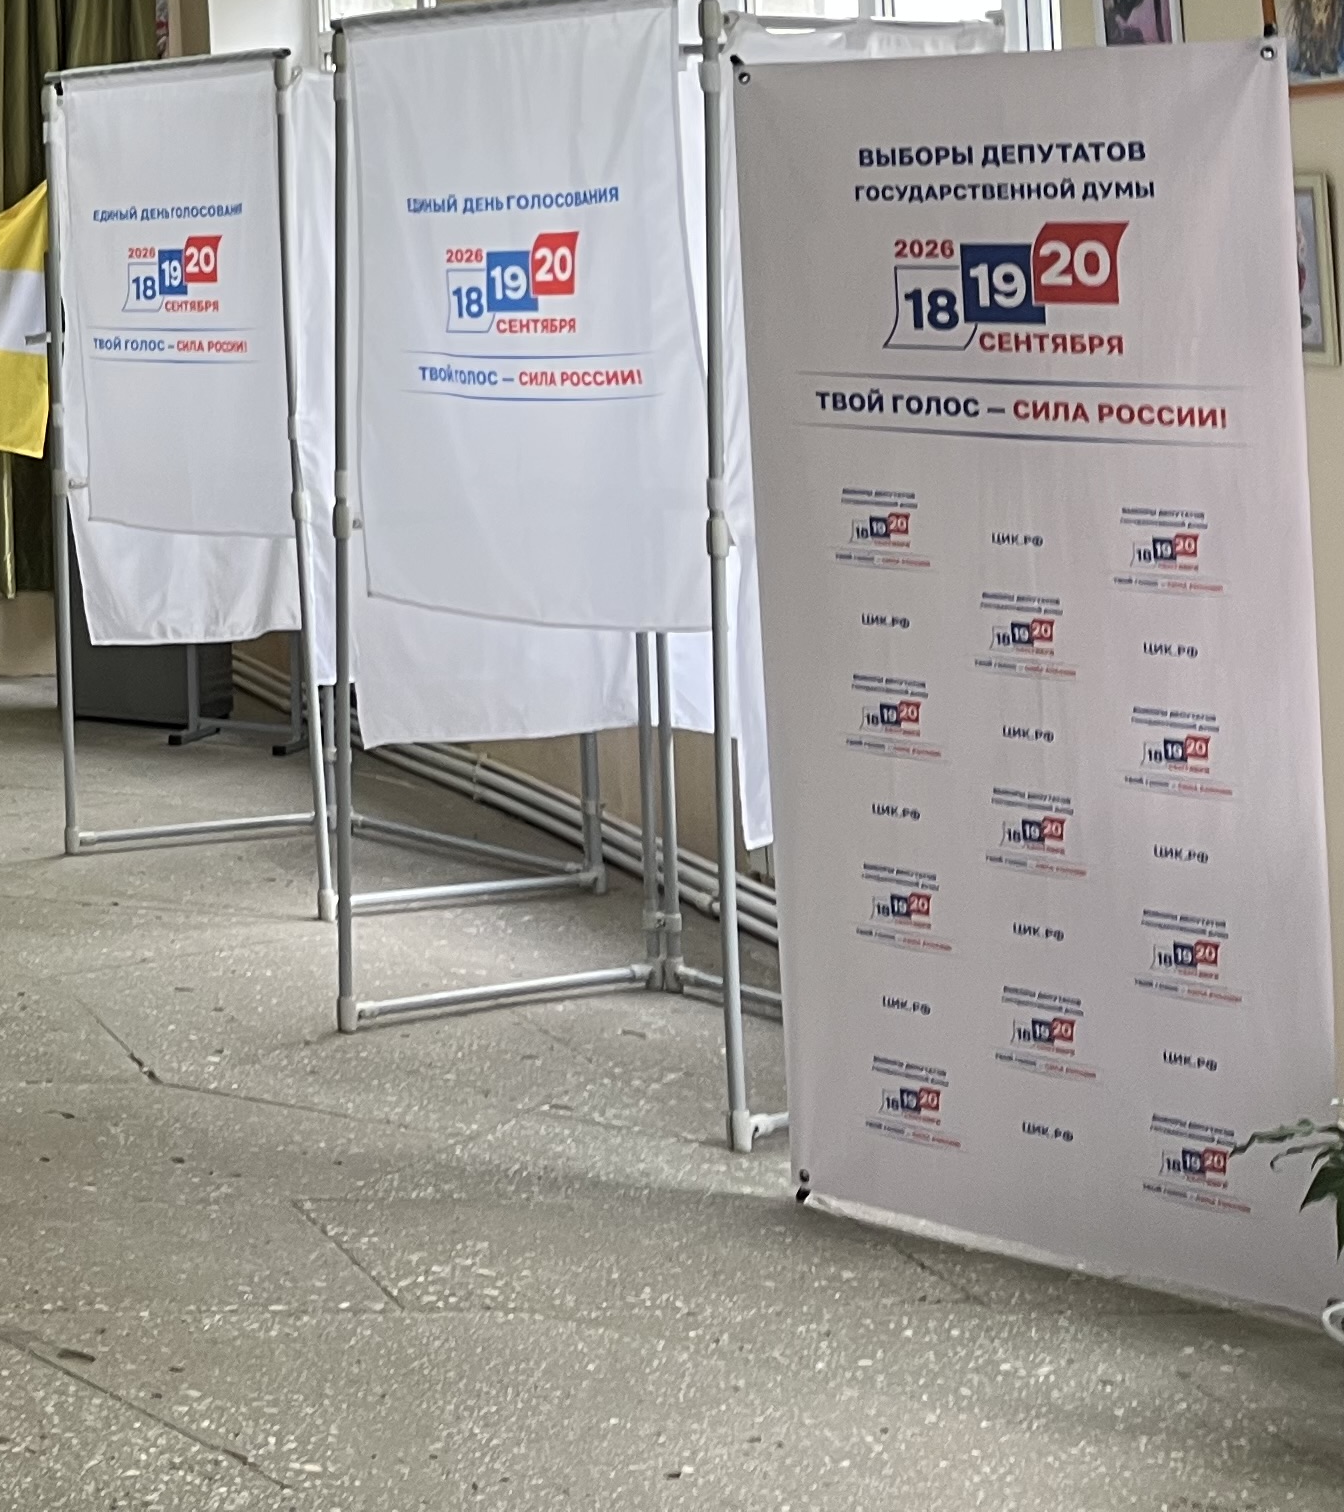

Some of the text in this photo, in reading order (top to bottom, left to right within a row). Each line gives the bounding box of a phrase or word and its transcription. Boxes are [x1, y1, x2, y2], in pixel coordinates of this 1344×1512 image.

[858, 141, 1146, 169] ВЫБОРЫ ДЕПУТАТОВ
[855, 178, 1155, 203] ГОСУДАРСТВЕННОЙ ДУМЫ
[463, 195, 503, 214] ДЕНЬ
[506, 186, 620, 211] ГОЛОСОВАНИЯ
[93, 206, 138, 223] ЕДИНЫЙ
[140, 207, 170, 222] ДЕНЬ
[128, 247, 155, 259] 2026
[446, 249, 483, 263] 2026
[895, 240, 955, 259] 2026
[132, 246, 215, 301] 18 19 20
[452, 246, 573, 319] 18 19 20
[904, 240, 1111, 331] 18 19 20
[165, 300, 220, 313] СЕНТЯБРЯ
[496, 318, 577, 334] СЕНТЯБРЯ
[93, 336, 122, 351] ТВОЙ
[124, 338, 165, 352] ГОЛОС
[176, 340, 204, 353] СИЛА
[979, 331, 1123, 356] СЕНТЯБРЯ
[519, 371, 557, 386] СИЛА
[560, 369, 643, 387] РОССИИ!
[815, 389, 884, 414] ТВОЙ
[892, 396, 980, 417] ГОЛОС
[1013, 400, 1090, 423] СИЛА
[1098, 402, 1227, 429] РОССИИ!
[889, 517, 906, 529] 20
[991, 532, 1044, 547] ЦИК.РФ
[1175, 538, 1195, 554] 20
[861, 612, 910, 629] ЦИК.РФ
[1032, 623, 1051, 637] 20
[1143, 641, 1198, 659] ЦИК.РФ
[900, 706, 917, 718] 20
[1003, 725, 1054, 743] ЦИК.РФ
[1186, 740, 1207, 754] 20
[872, 803, 921, 821] ЦИК.РФ
[1043, 821, 1061, 836] 20
[1154, 844, 1209, 864] ЦИК.РФ
[910, 898, 928, 911] 20
[1013, 921, 1064, 942] ЦИК.РФ
[1196, 945, 1215, 960] 20
[883, 995, 931, 1015] ЦИК.РФ
[1053, 1022, 1071, 1036] 20
[1163, 1050, 1218, 1071] ЦИК.РФ
[920, 1091, 937, 1106] 20
[1022, 1120, 1074, 1142] ЦИК.РФ
[1204, 1153, 1224, 1168] 20
